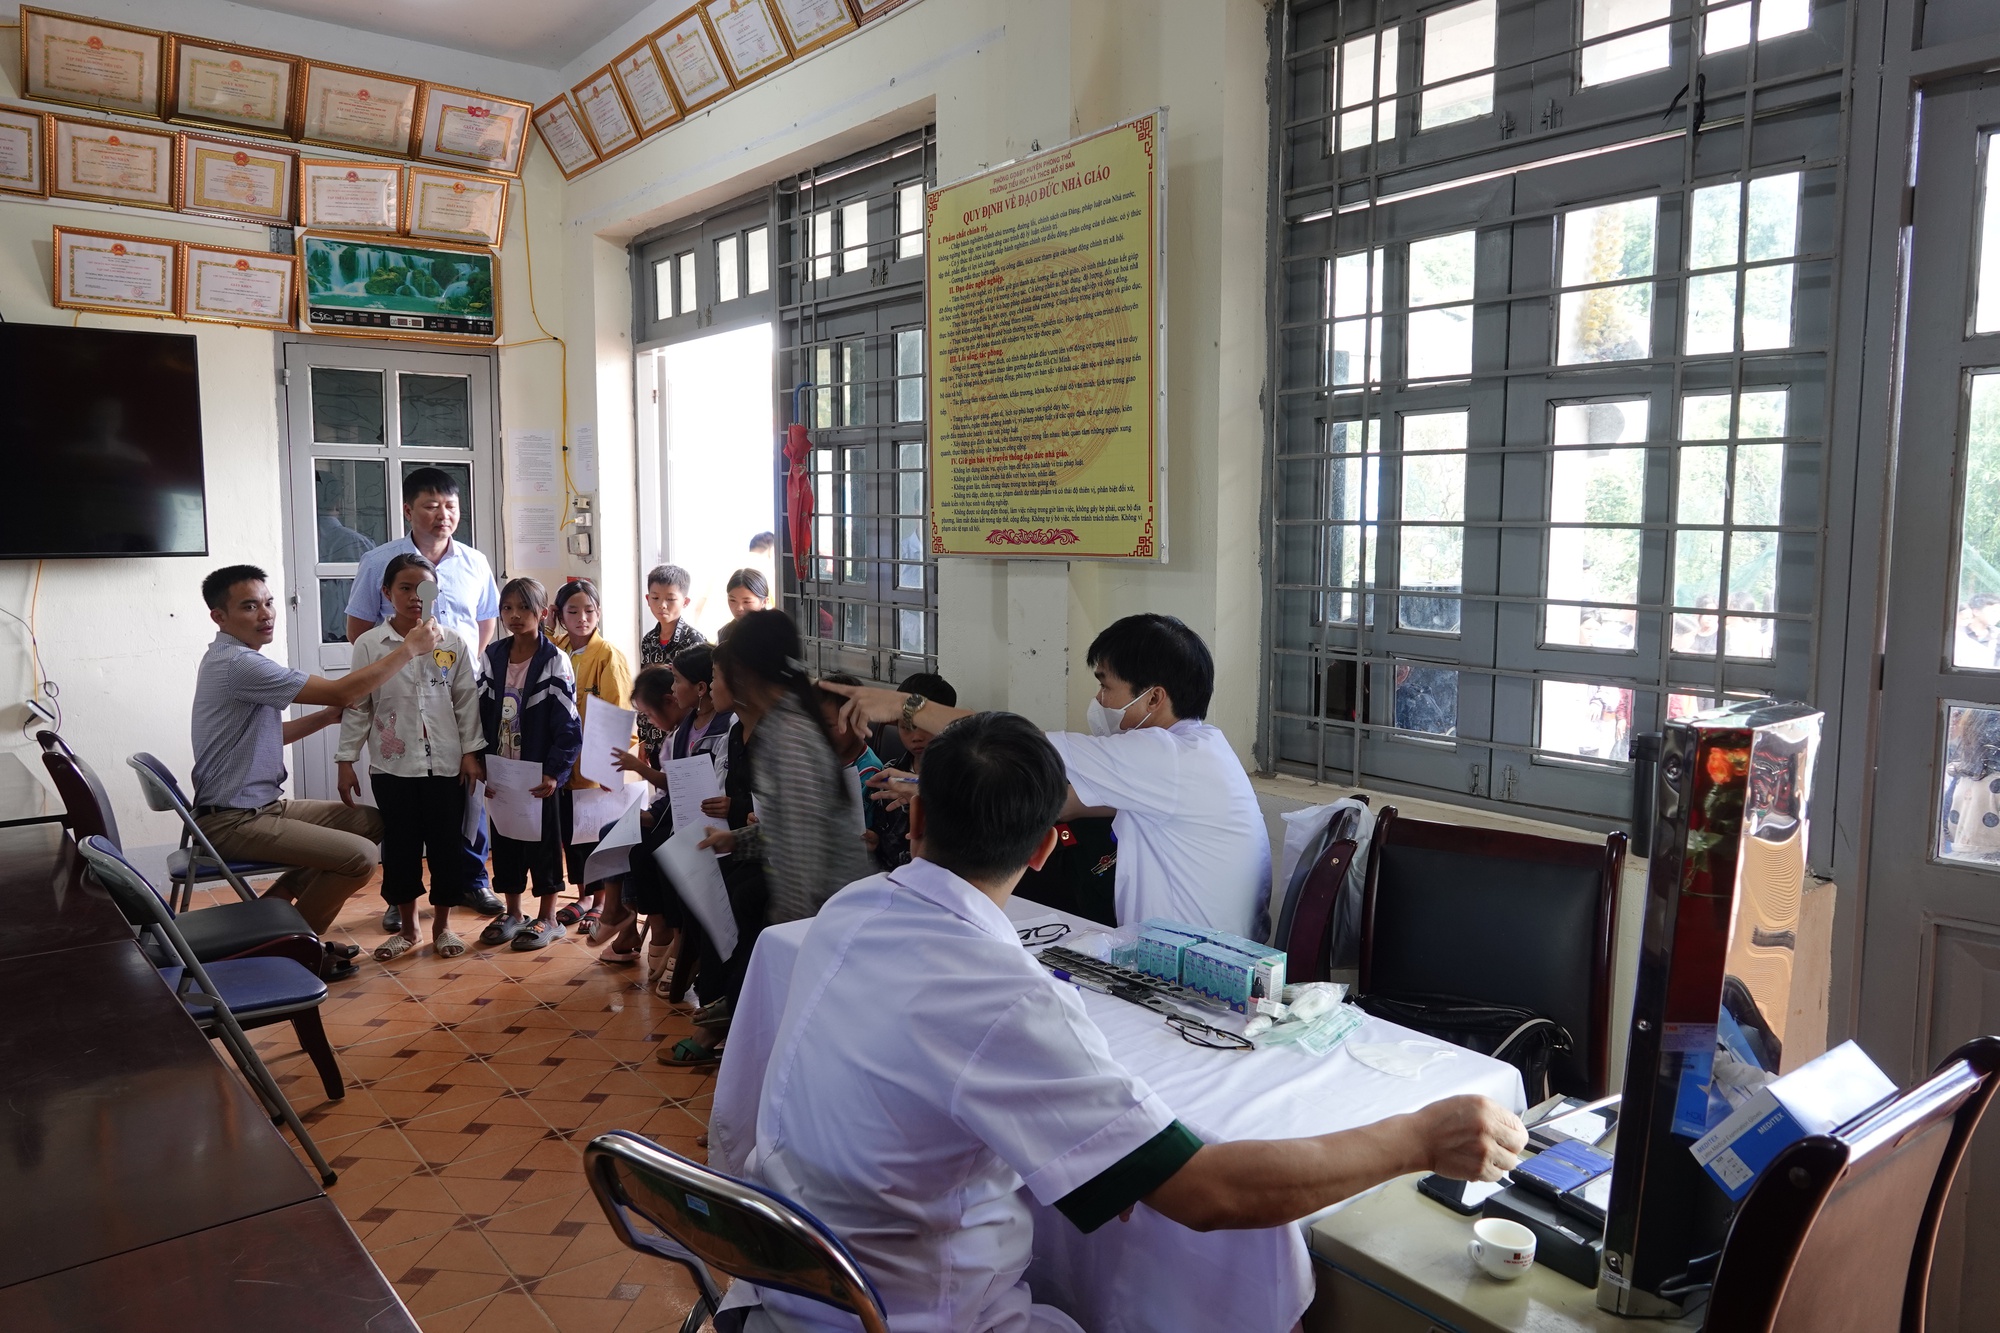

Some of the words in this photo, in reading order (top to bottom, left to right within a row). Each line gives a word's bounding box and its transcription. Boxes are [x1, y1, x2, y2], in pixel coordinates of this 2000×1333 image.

[963, 207, 980, 224] QUY
[982, 200, 1003, 218] ĐỊNH
[1005, 193, 1016, 210] VỀ
[1018, 190, 1037, 207] ĐẠO
[1039, 182, 1059, 200] ĐỨC
[1061, 173, 1082, 193] NHÀ
[1758, 1112, 1785, 1135] MEDITEX
[1697, 1135, 1719, 1153] MEDITEX
